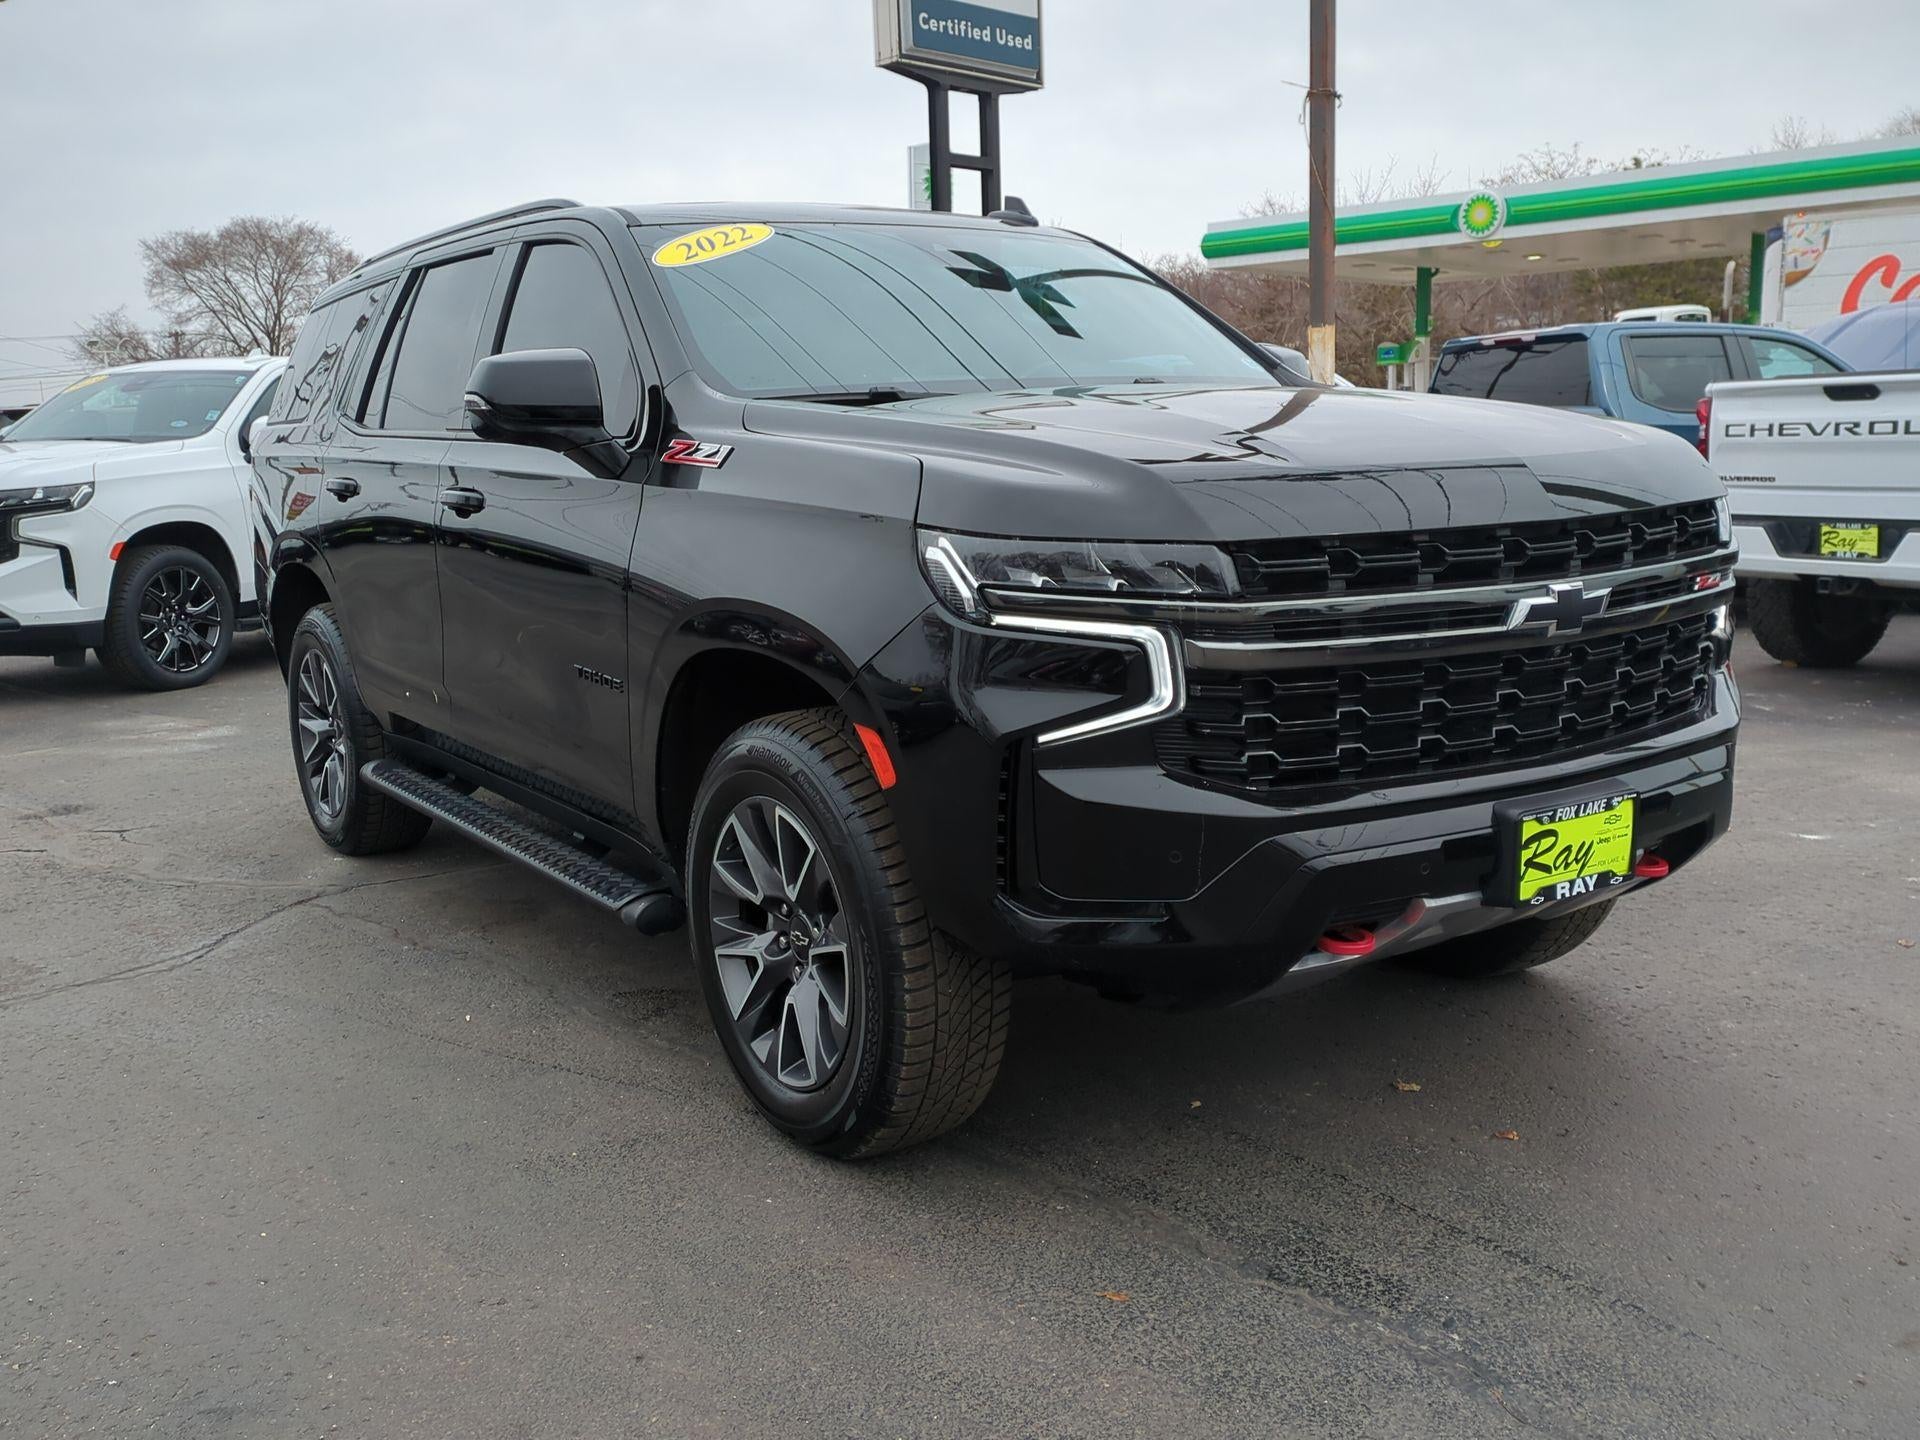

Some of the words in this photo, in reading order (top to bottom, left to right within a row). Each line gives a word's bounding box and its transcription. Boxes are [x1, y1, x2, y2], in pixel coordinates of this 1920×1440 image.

[918, 12, 991, 42] Certified
[996, 27, 1033, 50] Used
[675, 226, 753, 261] 2022
[1822, 530, 1858, 552] Ray
[1555, 804, 1578, 822] FOX
[1579, 799, 1607, 817] LAKE
[1521, 828, 1596, 881] Ray
[1556, 873, 1599, 900] RAY
